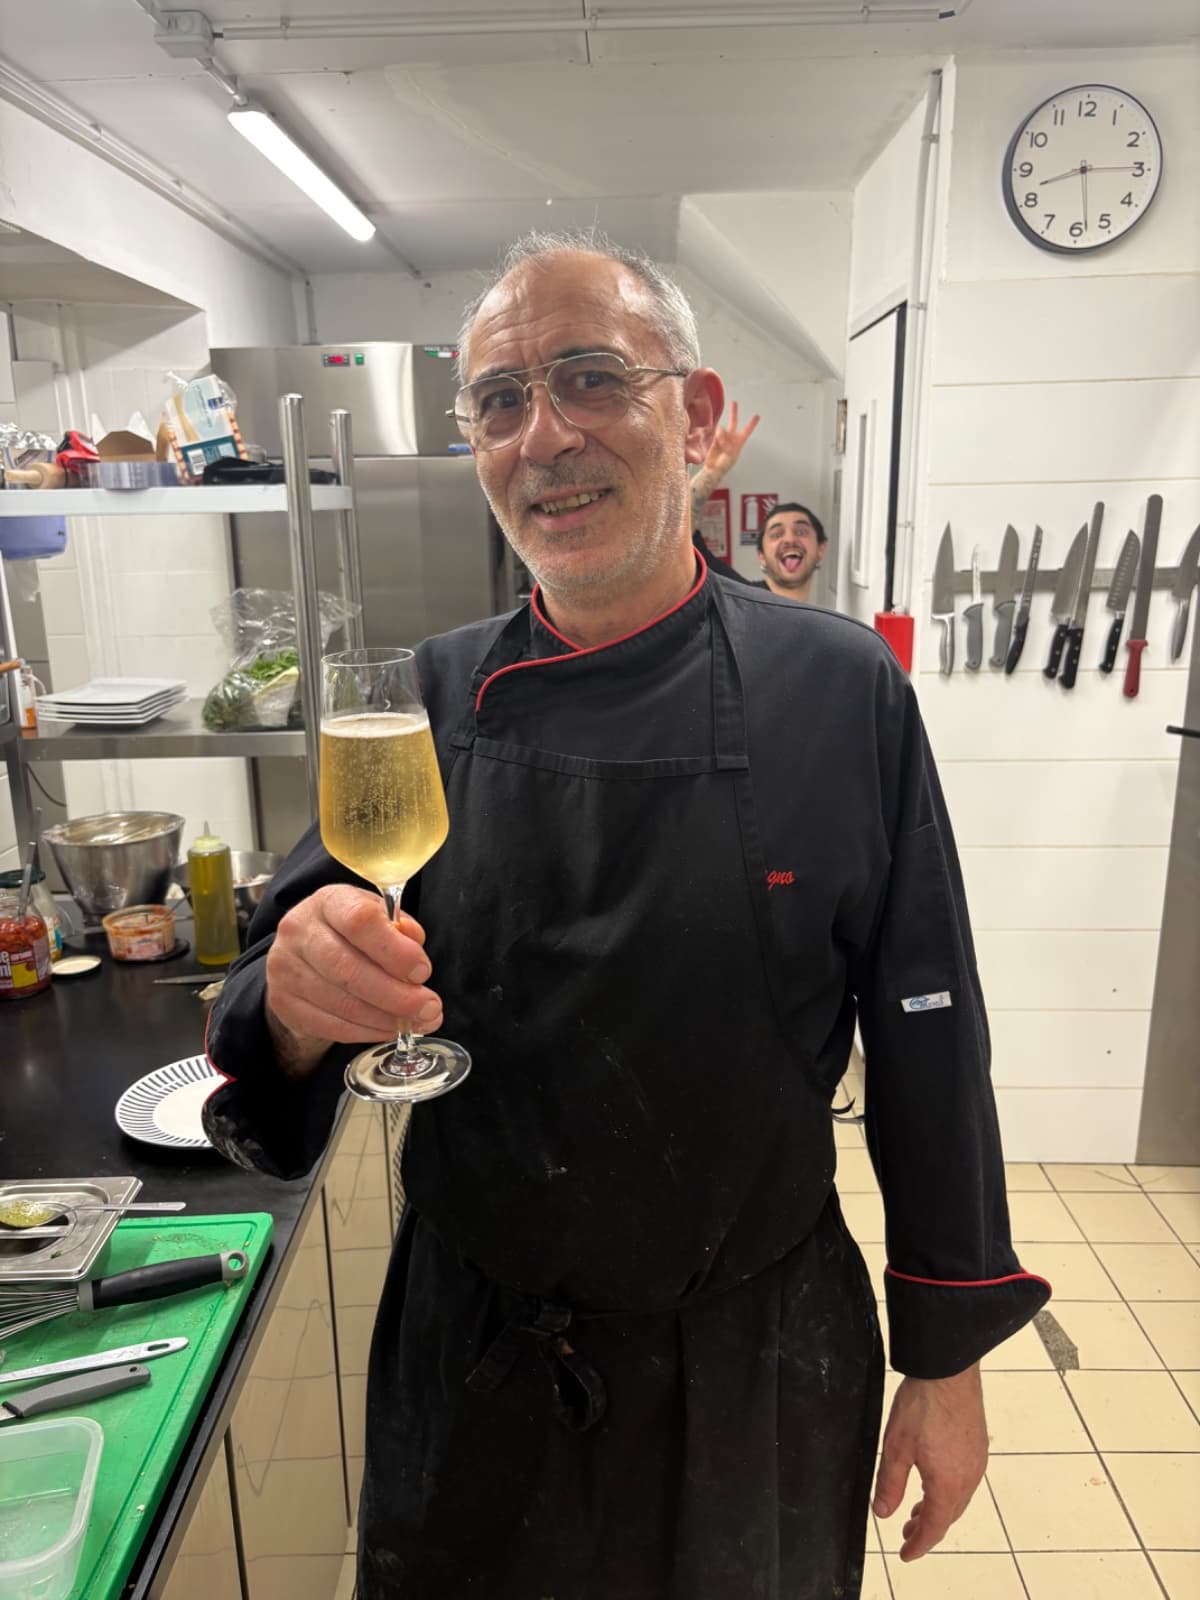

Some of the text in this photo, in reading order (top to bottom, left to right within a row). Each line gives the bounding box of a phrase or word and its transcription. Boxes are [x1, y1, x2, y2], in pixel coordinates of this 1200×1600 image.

[1078, 101, 1097, 117] 12
[1054, 109, 1065, 126] 11
[1112, 109, 1117, 126] 1
[1030, 131, 1048, 148] 10
[1126, 131, 1140, 148] 2
[1019, 162, 1033, 178] 9
[1131, 161, 1145, 177] 3
[1024, 192, 1038, 208] 8
[1120, 192, 1133, 207] 4
[1044, 214, 1056, 230] 7
[1098, 213, 1111, 229] 5
[1069, 222, 1084, 237] 6
[767, 869, 795, 891] gno
